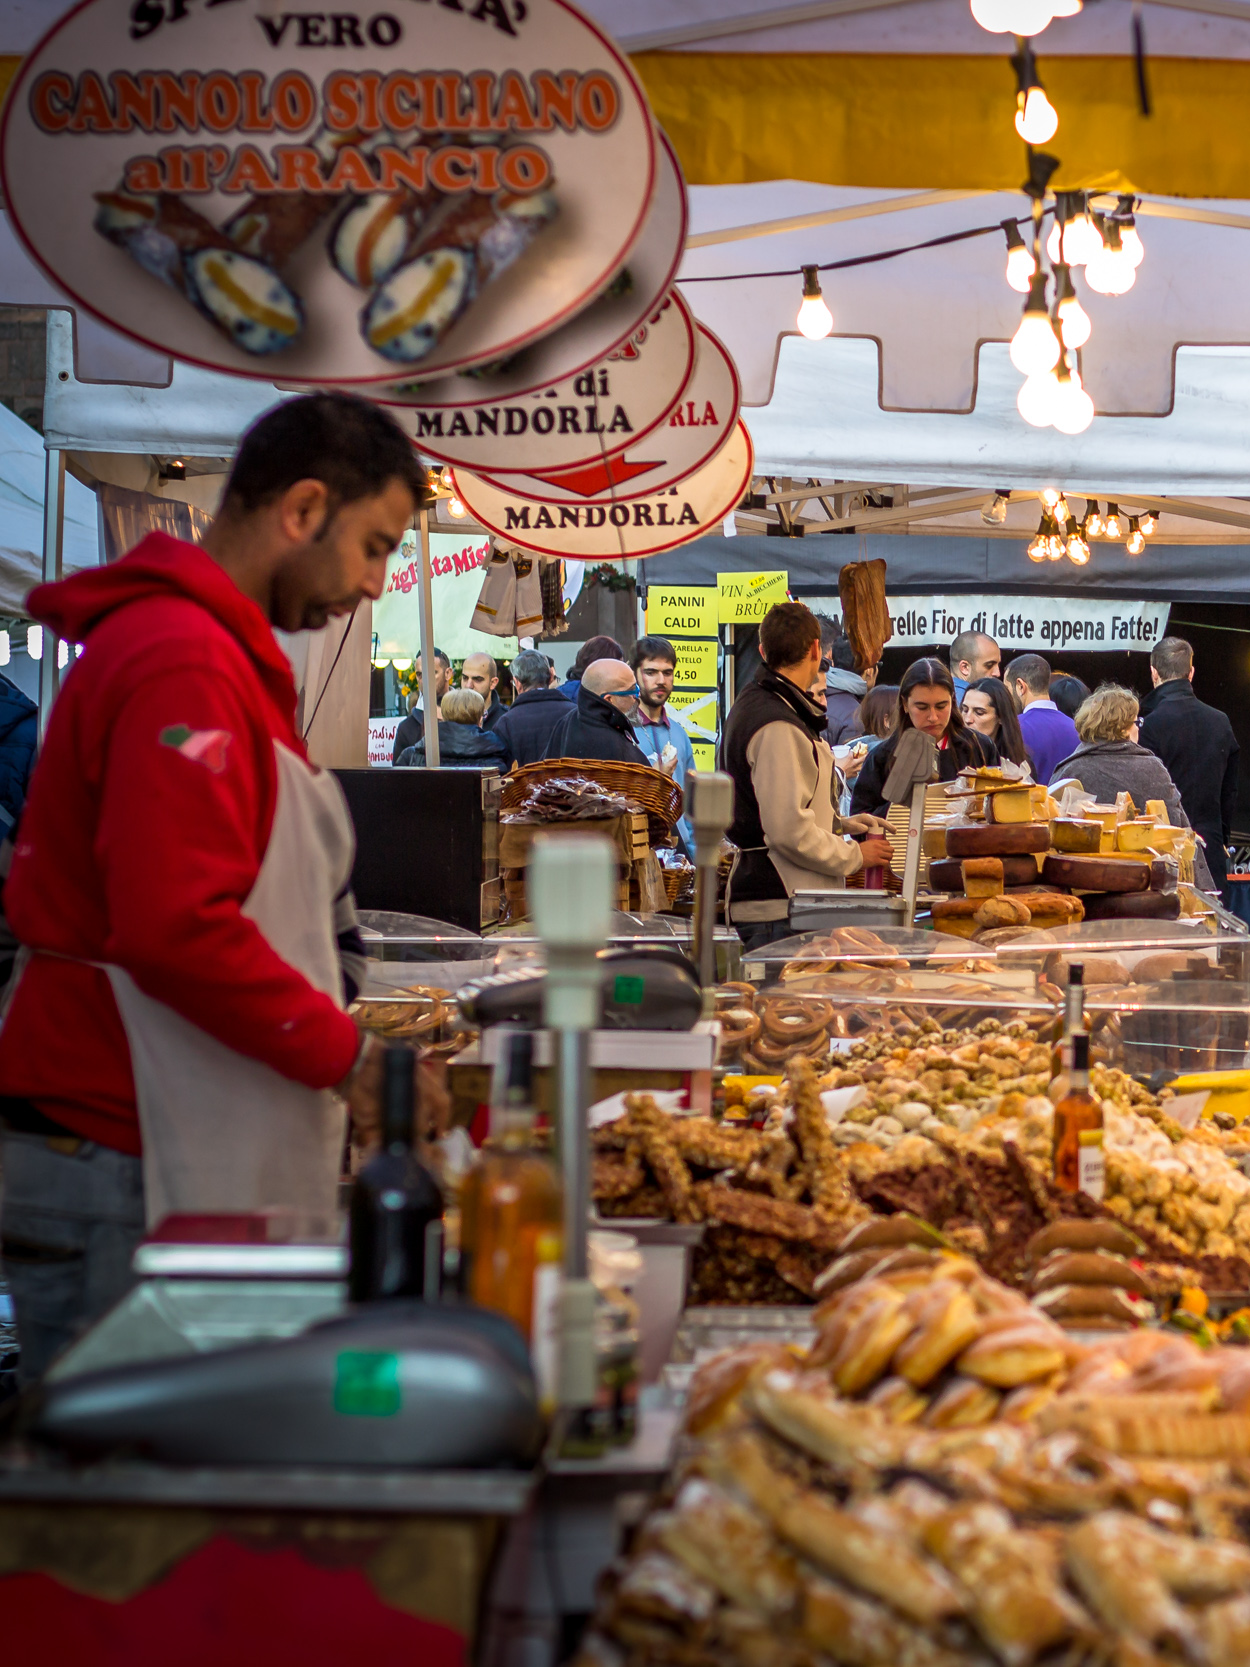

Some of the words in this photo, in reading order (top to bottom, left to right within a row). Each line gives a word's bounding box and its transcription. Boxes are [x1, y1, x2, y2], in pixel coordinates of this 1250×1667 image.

[255, 12, 403, 48] VERO
[29, 69, 317, 133] CANNOLO
[322, 69, 622, 133] SICILIANO
[124, 143, 553, 195] all'ARANCIO
[573, 368, 610, 397] di
[415, 404, 634, 438] MANDORLA
[504, 503, 700, 530] MANDORLA
[660, 596, 705, 608] PANINI
[721, 585, 744, 598] VIN
[735, 598, 780, 616] BRÛL
[664, 617, 700, 629] CALDI
[932, 609, 965, 635] Fior
[970, 611, 986, 633] di
[993, 612, 1034, 639] latte
[1040, 619, 1105, 648] appena
[1111, 616, 1159, 641] Fatte!
[674, 670, 697, 680] 4,50
